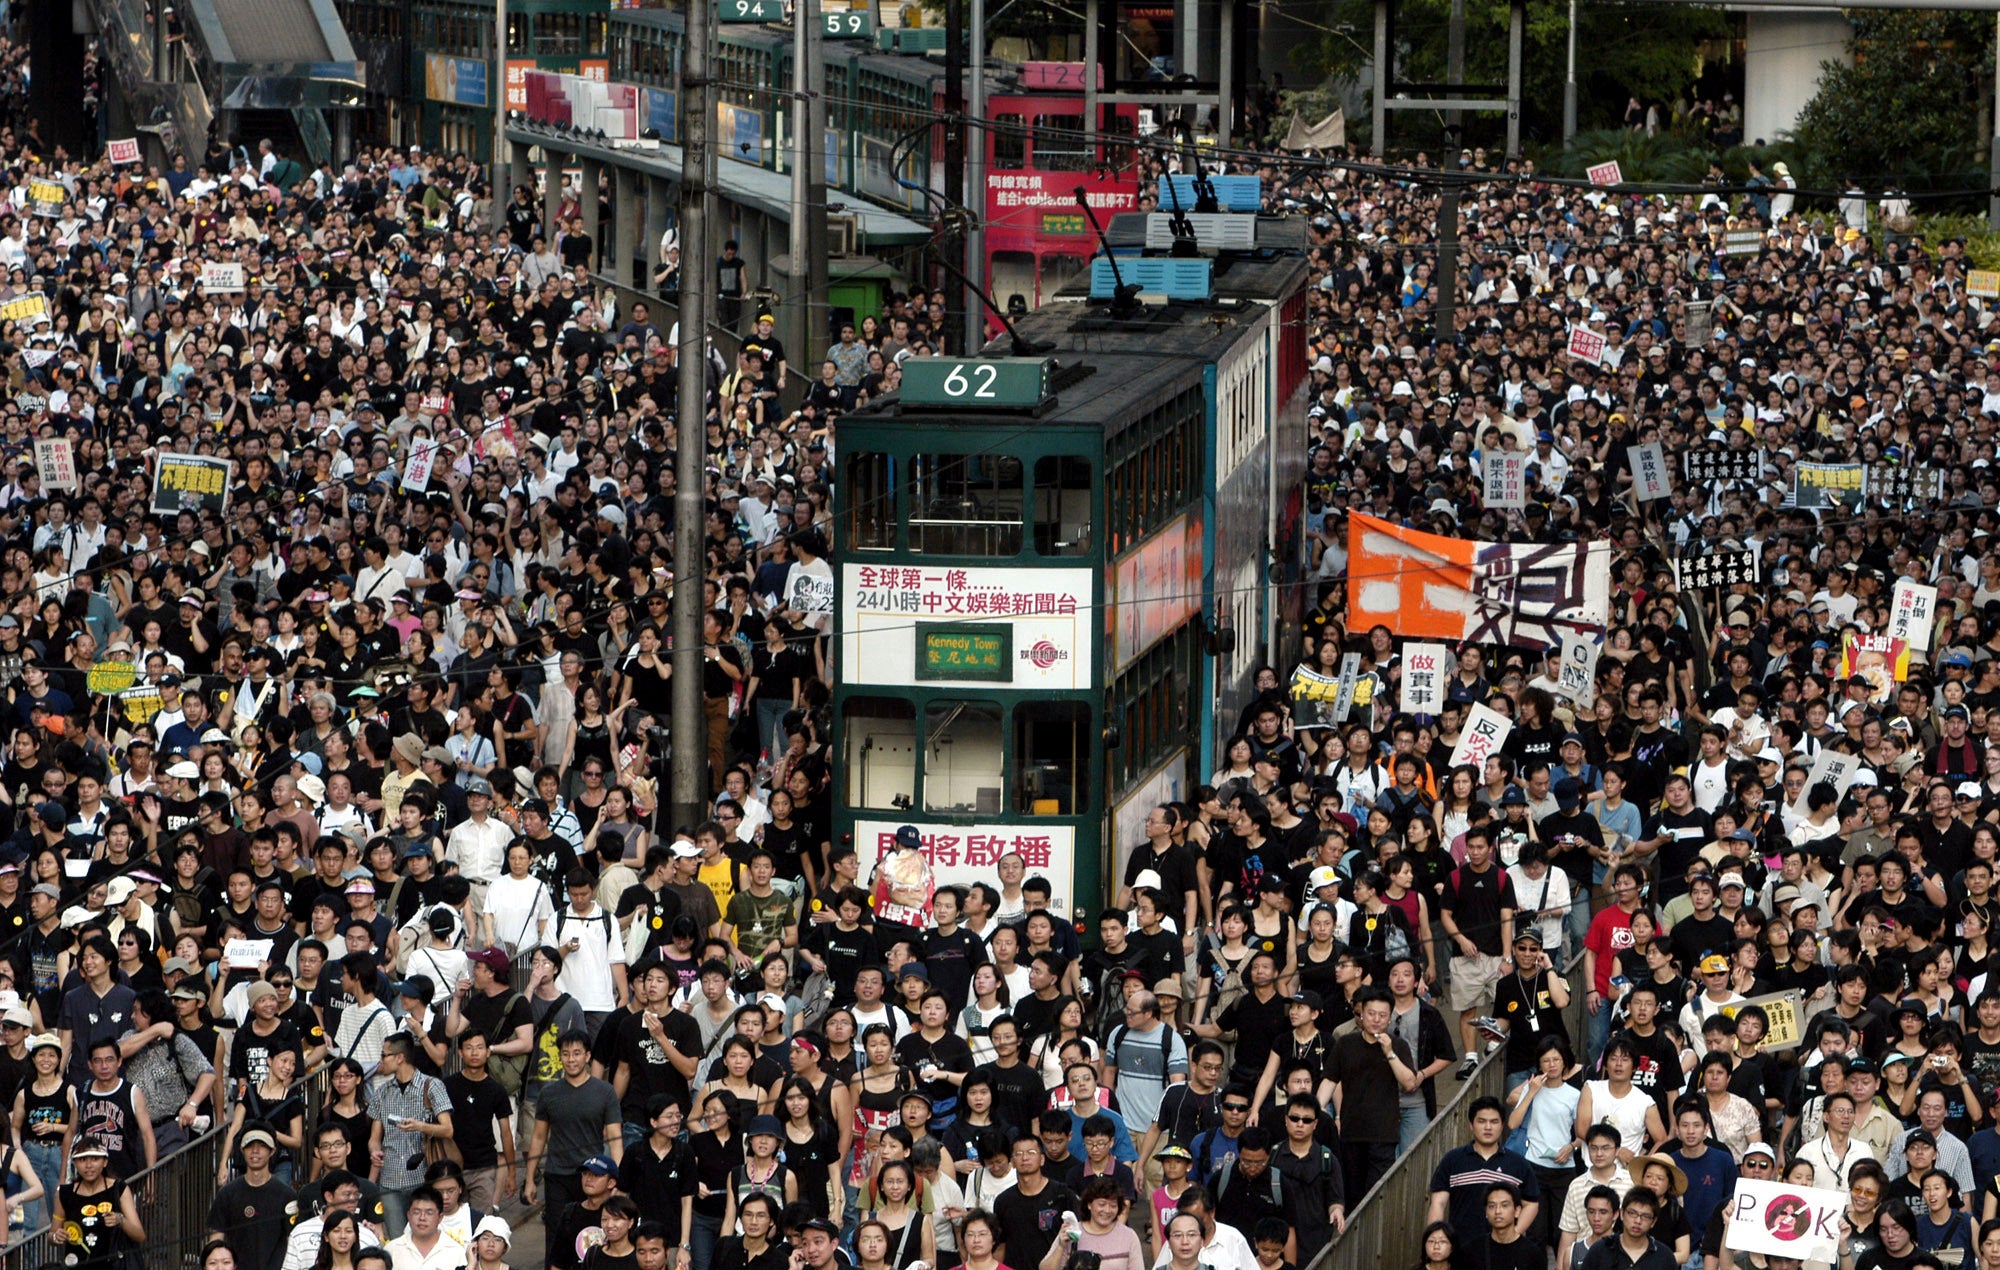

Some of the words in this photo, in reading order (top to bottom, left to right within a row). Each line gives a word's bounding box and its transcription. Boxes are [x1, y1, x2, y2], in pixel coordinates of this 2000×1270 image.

[736, 0, 764, 17] 94
[827, 15, 862, 33] 59
[943, 364, 997, 398] 62
[54, 443, 70, 481] 創作自由
[408, 443, 430, 484] 救港
[1506, 459, 1519, 500] 創作自由
[856, 590, 1078, 615] 24小時中文娛樂新聞台
[1912, 595, 1928, 620] 打倒
[927, 634, 970, 650] Kennedy
[974, 636, 999, 650] Town
[1462, 717, 1499, 769] 反吹水
